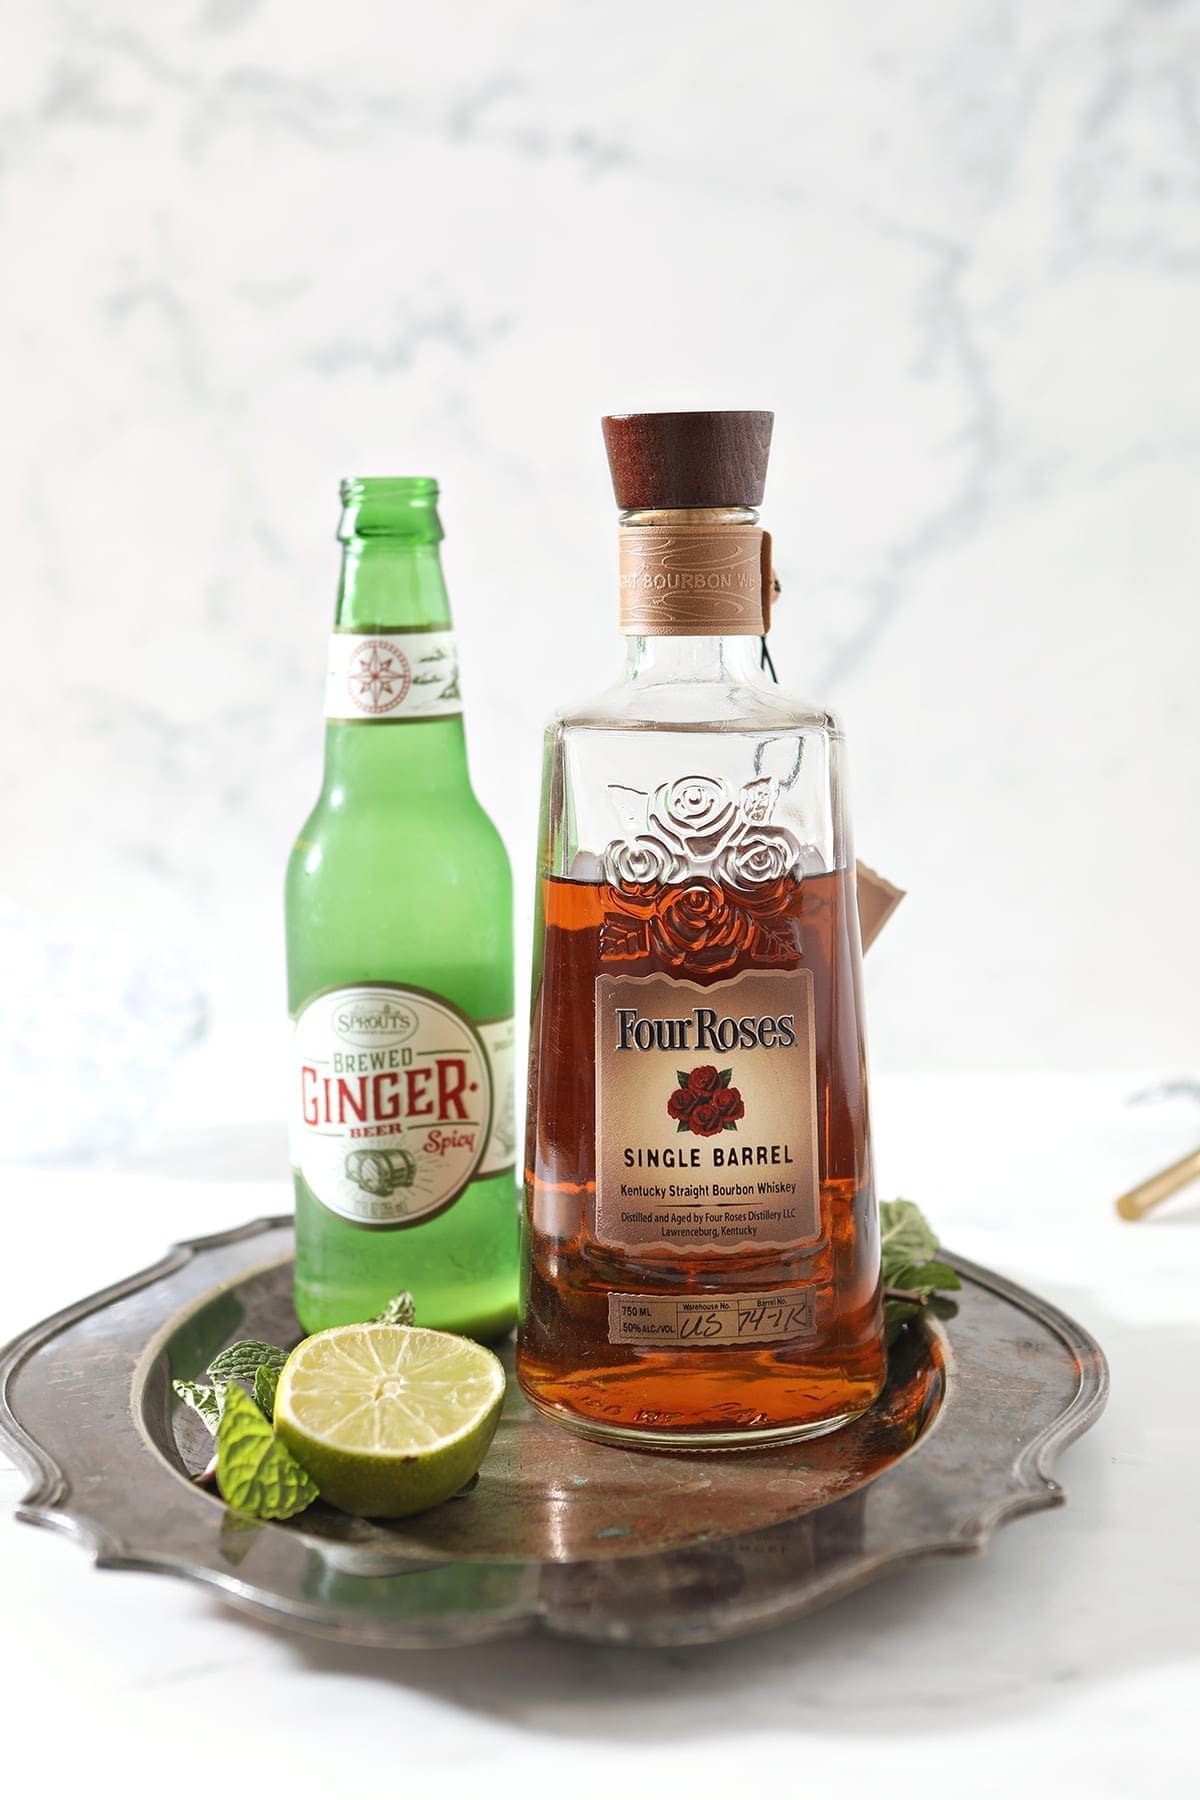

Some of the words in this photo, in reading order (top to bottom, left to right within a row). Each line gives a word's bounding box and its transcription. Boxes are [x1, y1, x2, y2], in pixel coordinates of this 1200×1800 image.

[643, 573, 731, 589] BOURBON
[338, 1014, 411, 1033] SPROUTS
[615, 1008, 693, 1051] Four
[692, 1007, 797, 1053] Roses
[333, 1048, 413, 1074] BREWED
[301, 1059, 471, 1126] GINGER
[350, 1123, 403, 1139] BEER
[423, 1129, 476, 1157] Spicy
[624, 1148, 701, 1168] SINGLE
[713, 1145, 794, 1166] BARREL
[620, 1184, 666, 1199] Kentucky
[669, 1184, 709, 1199] Straight
[712, 1183, 754, 1196] Bourbon
[757, 1181, 796, 1195] Whiskey
[621, 1212, 652, 1223] Distilled
[654, 1212, 669, 1223] and
[671, 1212, 692, 1225] Aged
[693, 1212, 704, 1224] by
[705, 1213, 723, 1223] Four
[724, 1211, 747, 1222] Roses
[748, 1209, 782, 1221] Distillery
[783, 1208, 796, 1219] LLC
[661, 1226, 720, 1239] Lawrenceburg,
[721, 1225, 757, 1237] Kentucky
[622, 1306, 638, 1317] 750
[639, 1307, 652, 1317] ML
[682, 1303, 719, 1311] Warehouse
[719, 1302, 731, 1310] No.
[756, 1299, 776, 1307] Barrel
[623, 1322, 641, 1333] 50%
